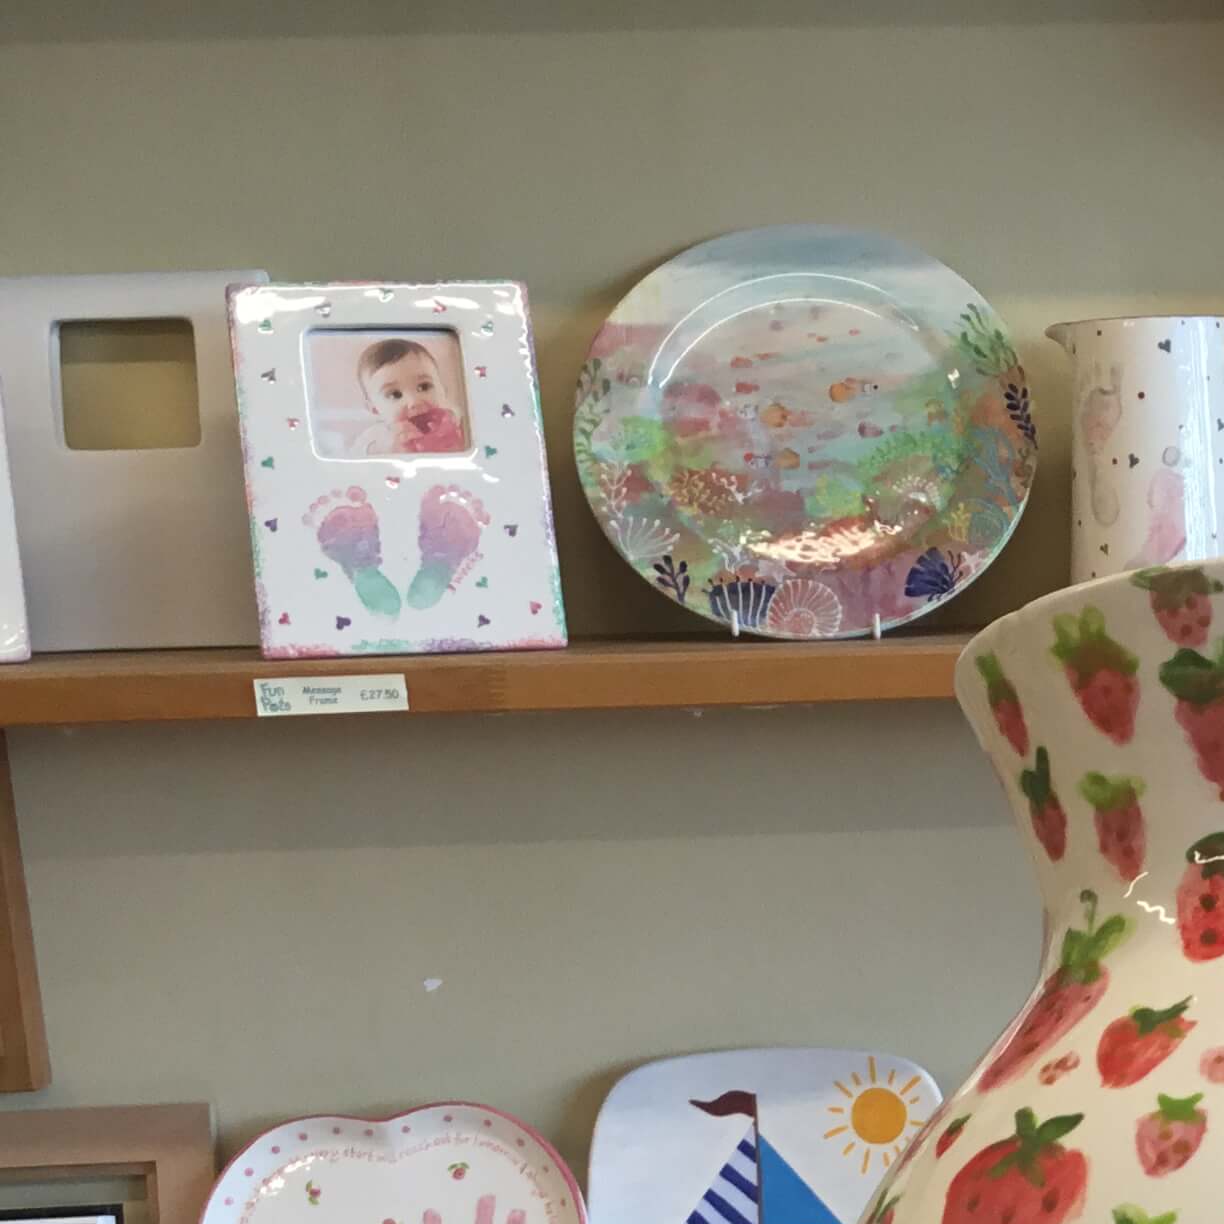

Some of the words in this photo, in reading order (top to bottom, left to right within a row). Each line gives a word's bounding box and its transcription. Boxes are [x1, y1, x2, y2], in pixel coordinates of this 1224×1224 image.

[260, 682, 285, 697] Fun
[360, 689, 400, 701] £27.50
[261, 695, 292, 712] Pots
